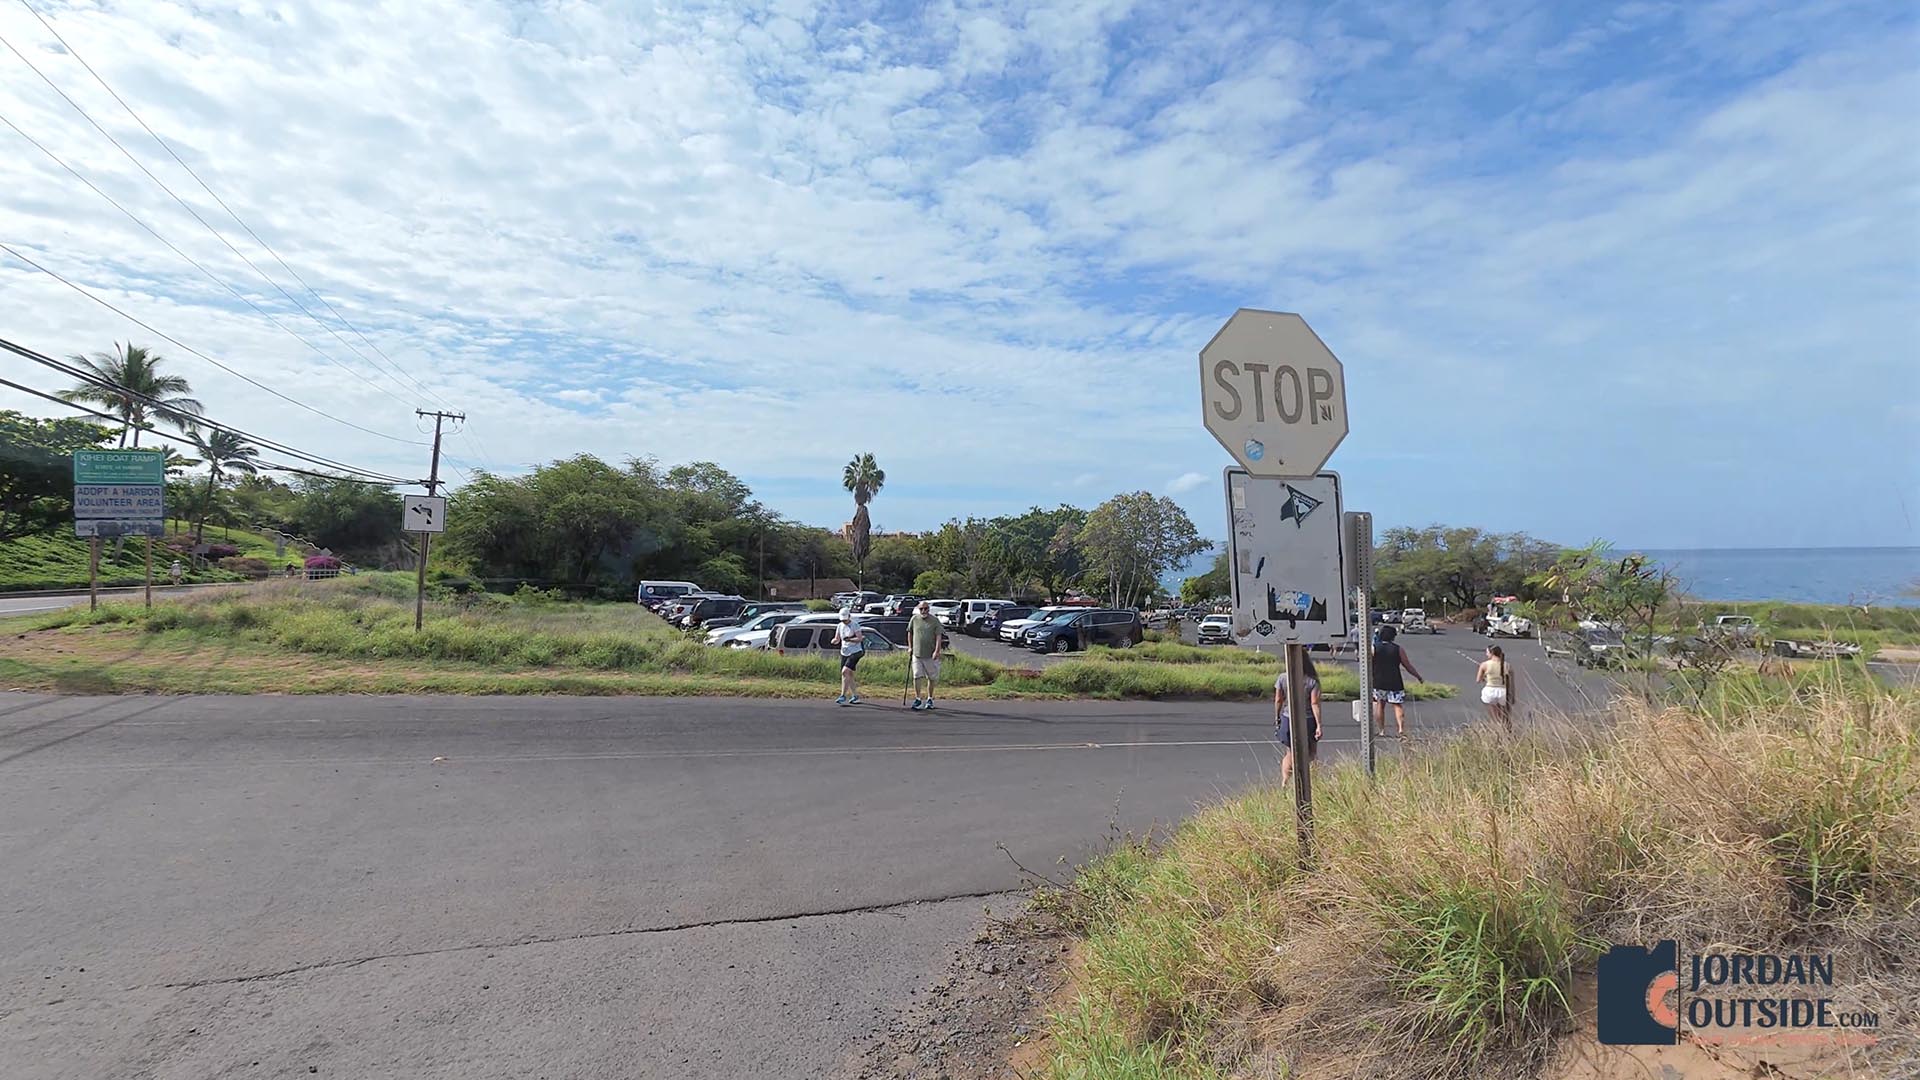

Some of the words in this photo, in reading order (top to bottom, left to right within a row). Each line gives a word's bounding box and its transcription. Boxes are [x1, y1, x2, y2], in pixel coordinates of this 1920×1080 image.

[1213, 359, 1334, 425] STOP
[80, 454, 104, 462] KIHEI
[107, 454, 129, 462] BOAT
[77, 487, 108, 496] ADOPT
[112, 487, 119, 496] A
[122, 487, 160, 496] HARBOR
[77, 498, 133, 507] VOLUNTEER
[136, 498, 160, 507] AREA
